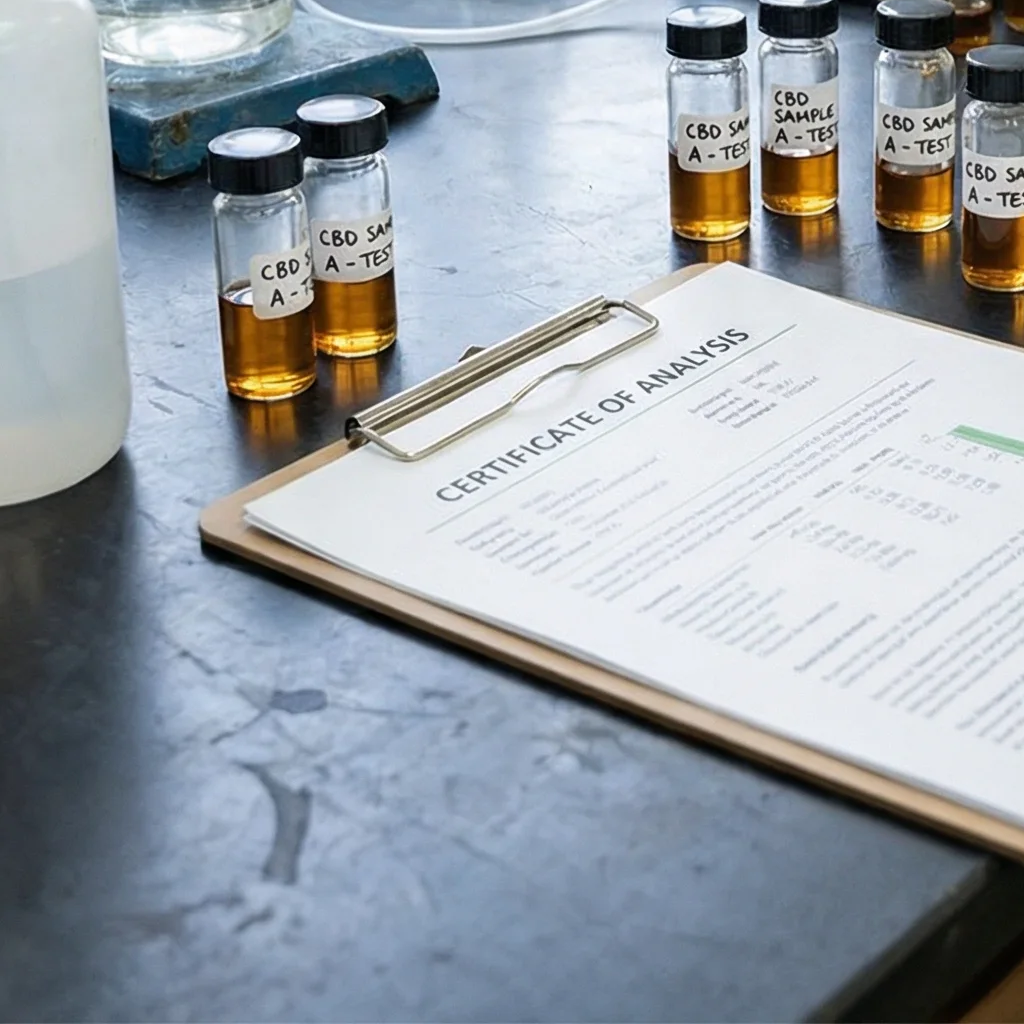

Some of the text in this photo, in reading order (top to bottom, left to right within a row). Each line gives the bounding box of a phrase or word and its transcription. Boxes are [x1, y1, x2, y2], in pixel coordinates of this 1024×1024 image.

[775, 90, 809, 107] CBD
[774, 103, 834, 124] SAMPLE
[882, 113, 915, 131] CBD
[685, 123, 722, 140] CBD
[775, 127, 788, 144] A
[884, 135, 896, 153] A
[914, 134, 952, 155] TEST
[688, 146, 702, 163] A
[965, 161, 997, 182] CBD
[968, 186, 979, 204] A
[319, 229, 358, 247] CBD
[261, 258, 300, 280] CBD
[325, 255, 340, 273] A
[270, 288, 285, 307] A
[435, 409, 604, 503] CERTIFICATE
[597, 388, 638, 415] OF
[635, 327, 750, 394] ANALYSIS
